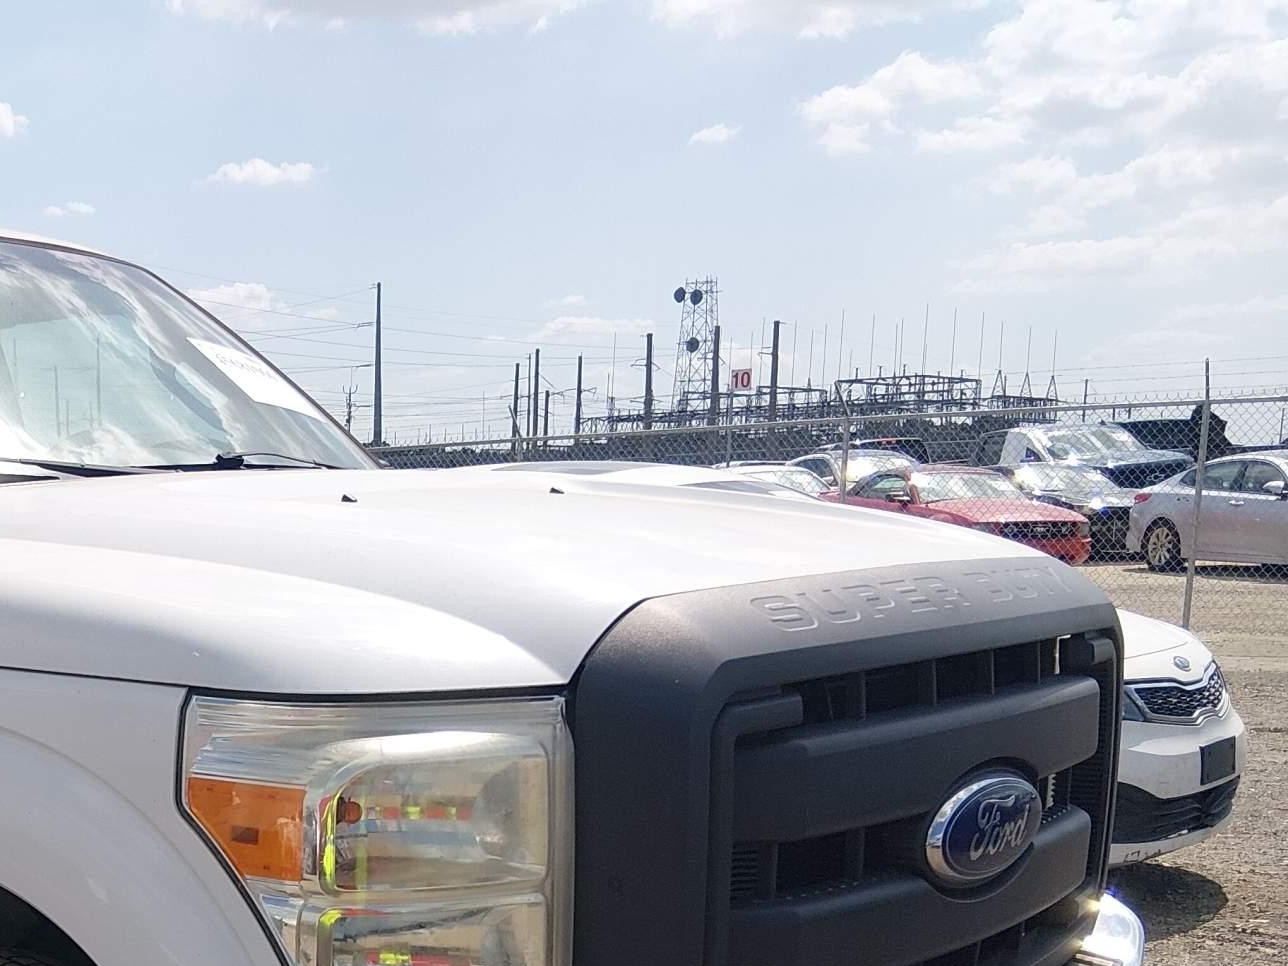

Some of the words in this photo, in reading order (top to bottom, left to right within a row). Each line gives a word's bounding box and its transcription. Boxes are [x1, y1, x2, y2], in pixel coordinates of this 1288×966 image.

[732, 371, 751, 389] 10
[749, 576, 971, 633] SUPER
[968, 794, 1030, 861] Ford
